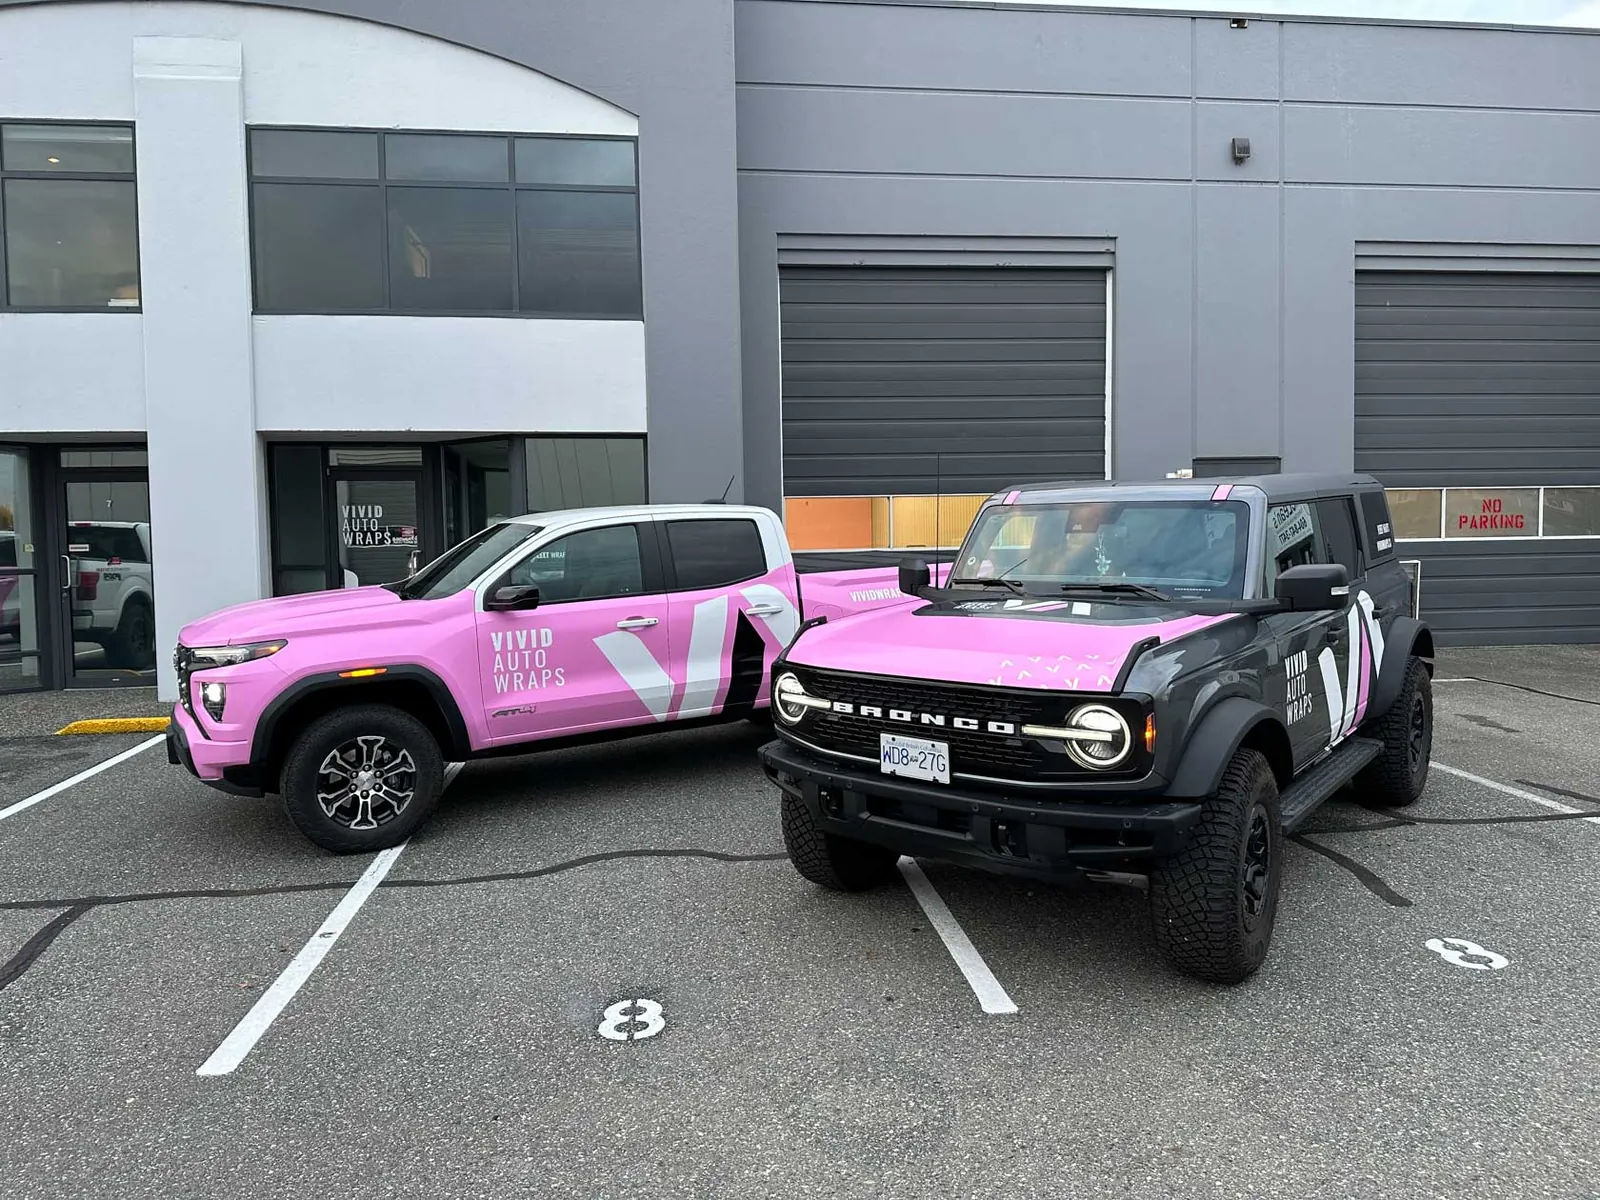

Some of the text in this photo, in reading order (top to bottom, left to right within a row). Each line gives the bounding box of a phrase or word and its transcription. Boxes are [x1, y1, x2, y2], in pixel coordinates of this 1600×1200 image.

[341, 505, 383, 518] VIVID
[1482, 498, 1502, 513] NO
[342, 518, 378, 532] AUTO
[1458, 514, 1524, 529] PARKING
[342, 531, 391, 545] WRAPS
[490, 628, 553, 652] VIVID
[493, 649, 546, 673] AUTO
[1284, 649, 1308, 680] VIVID
[493, 667, 565, 694] WRAPS
[1286, 673, 1306, 704] AUTO
[832, 701, 1015, 735] BRONCO
[1286, 692, 1313, 726] WRAPS
[883, 745, 946, 773] WD8 27G
[1425, 937, 1509, 970] 8
[598, 998, 665, 1041] 8
